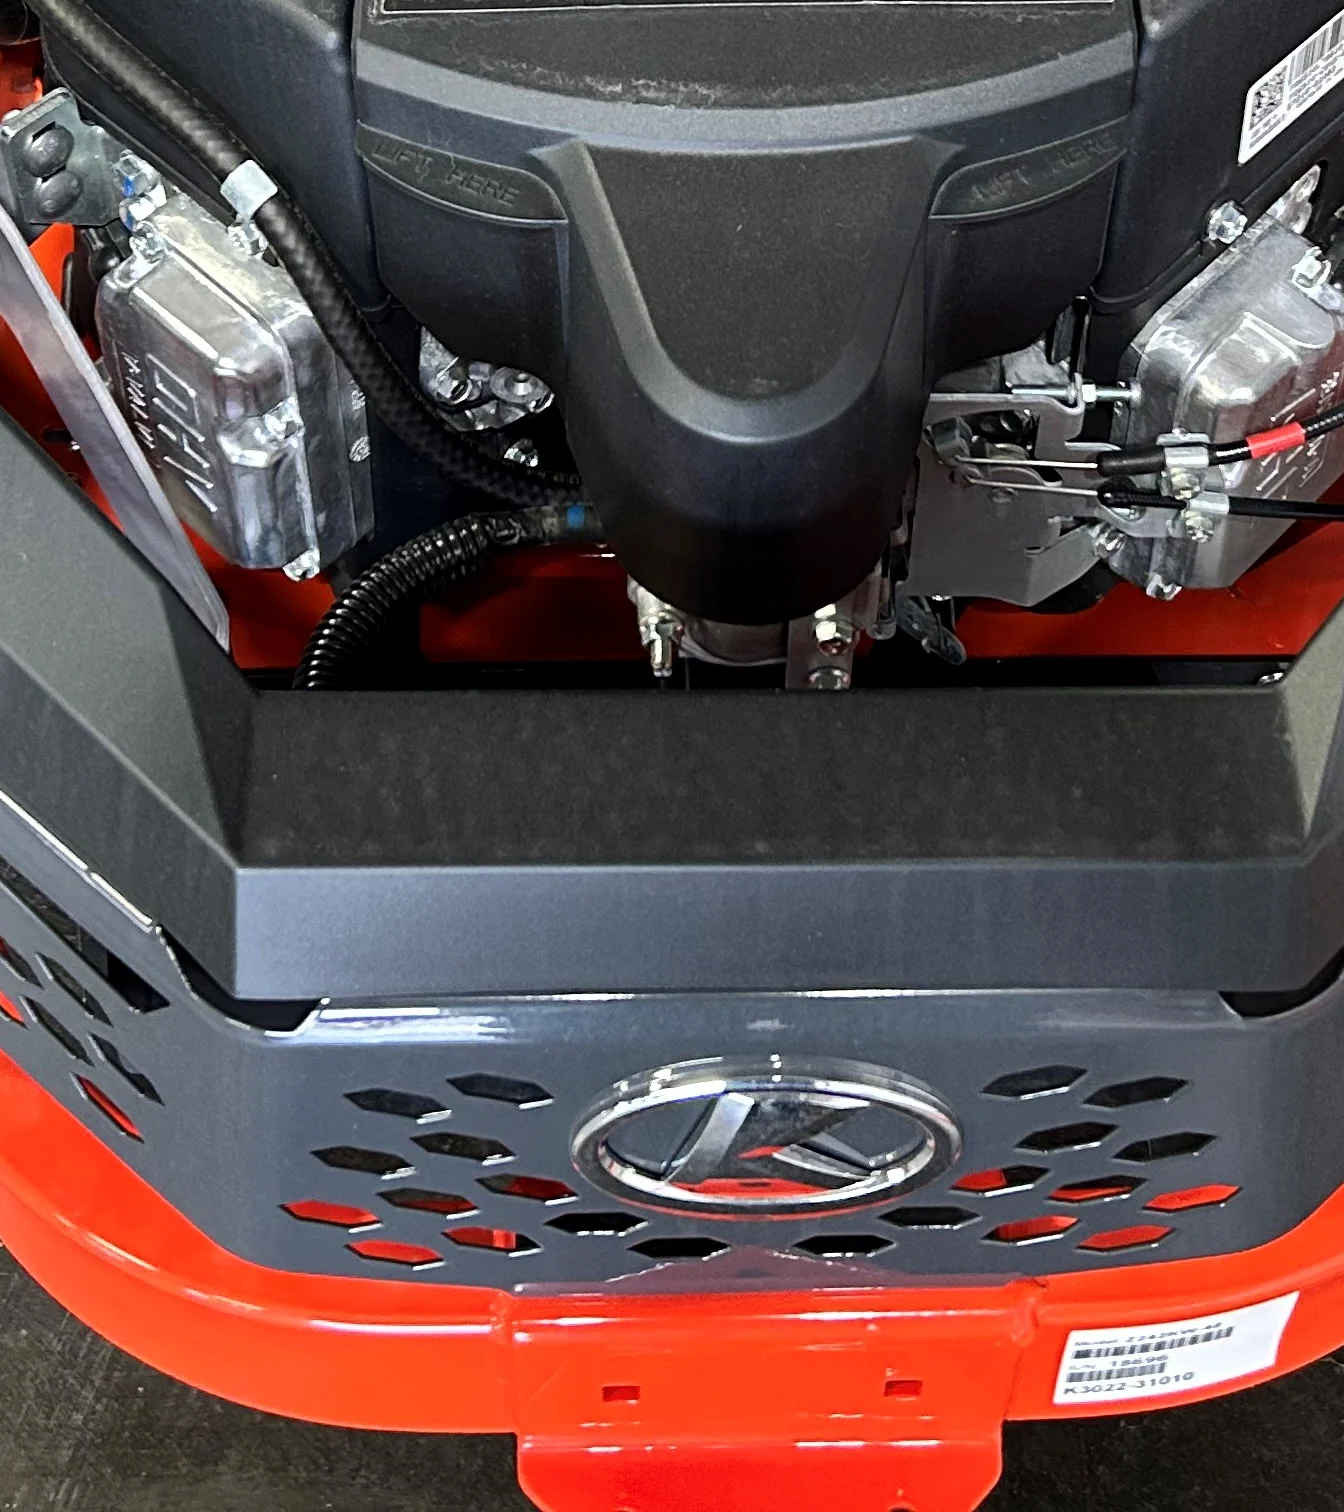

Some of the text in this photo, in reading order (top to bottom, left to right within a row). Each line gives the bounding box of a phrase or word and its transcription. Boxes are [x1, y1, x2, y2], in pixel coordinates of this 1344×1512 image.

[370, 140, 520, 208] LIFT HERE
[1063, 1371, 1196, 1394] K3022-31010
